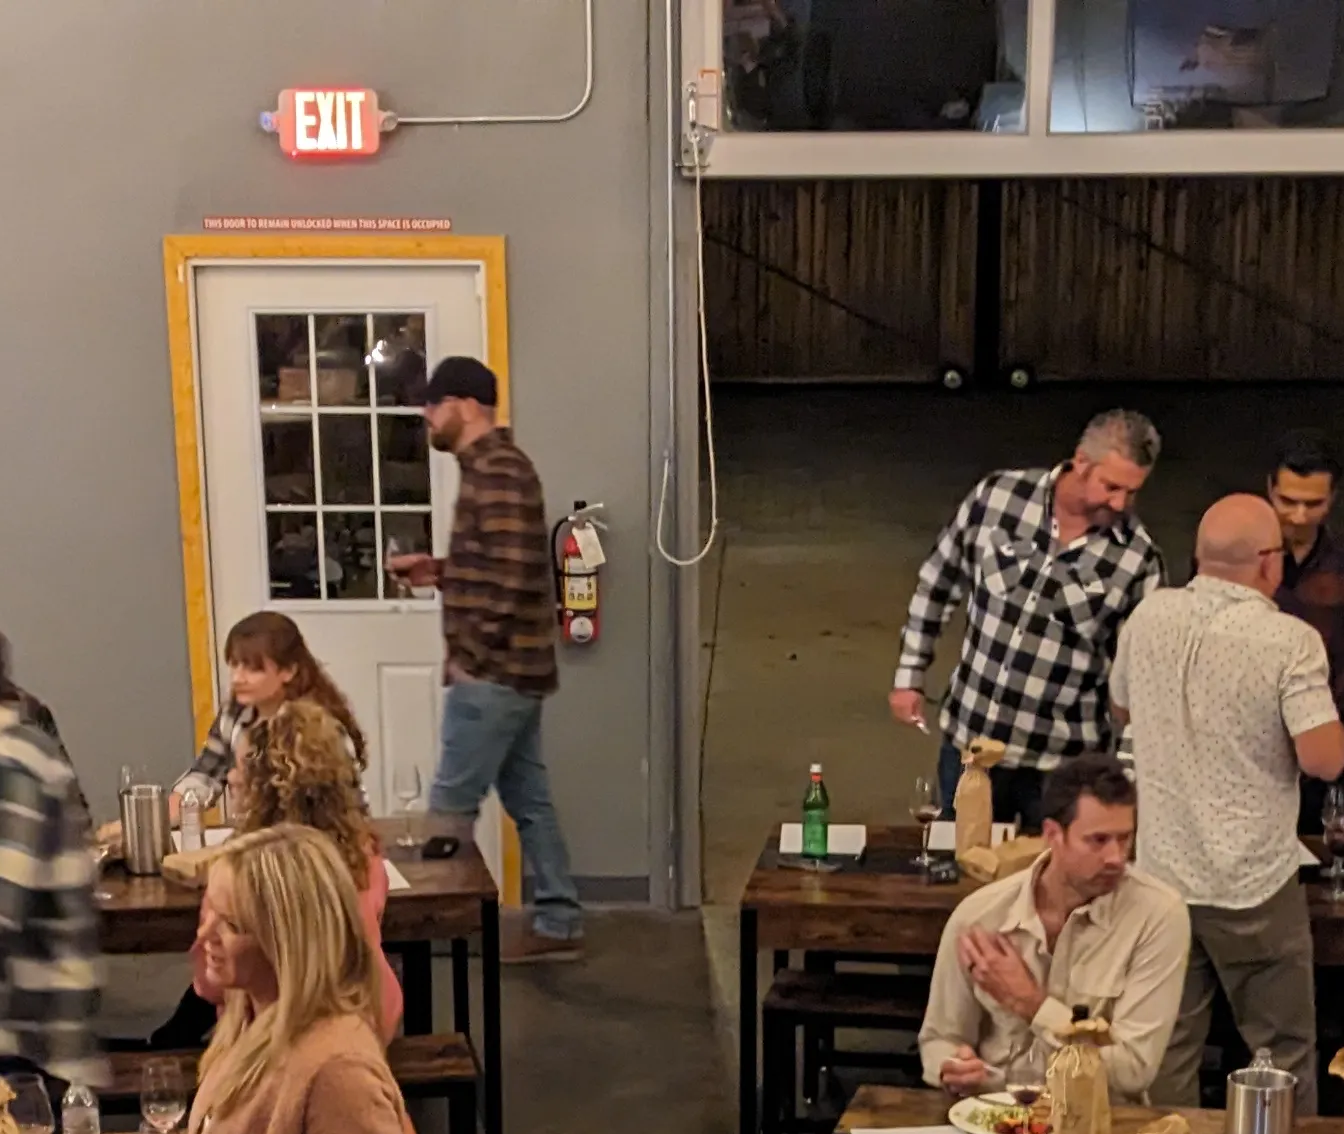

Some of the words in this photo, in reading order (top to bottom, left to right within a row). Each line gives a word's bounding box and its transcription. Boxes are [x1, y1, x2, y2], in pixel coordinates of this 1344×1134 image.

[294, 91, 366, 151] EXIT
[204, 218, 222, 229] THIS
[223, 218, 246, 229] DOOR
[247, 218, 257, 229] TO
[258, 218, 290, 229] REMAIN
[291, 218, 332, 229] UNLOCKED
[359, 218, 377, 229] THIS
[378, 218, 401, 229] SPACE
[402, 218, 411, 229] IS
[411, 218, 451, 229] OCCUPIED
